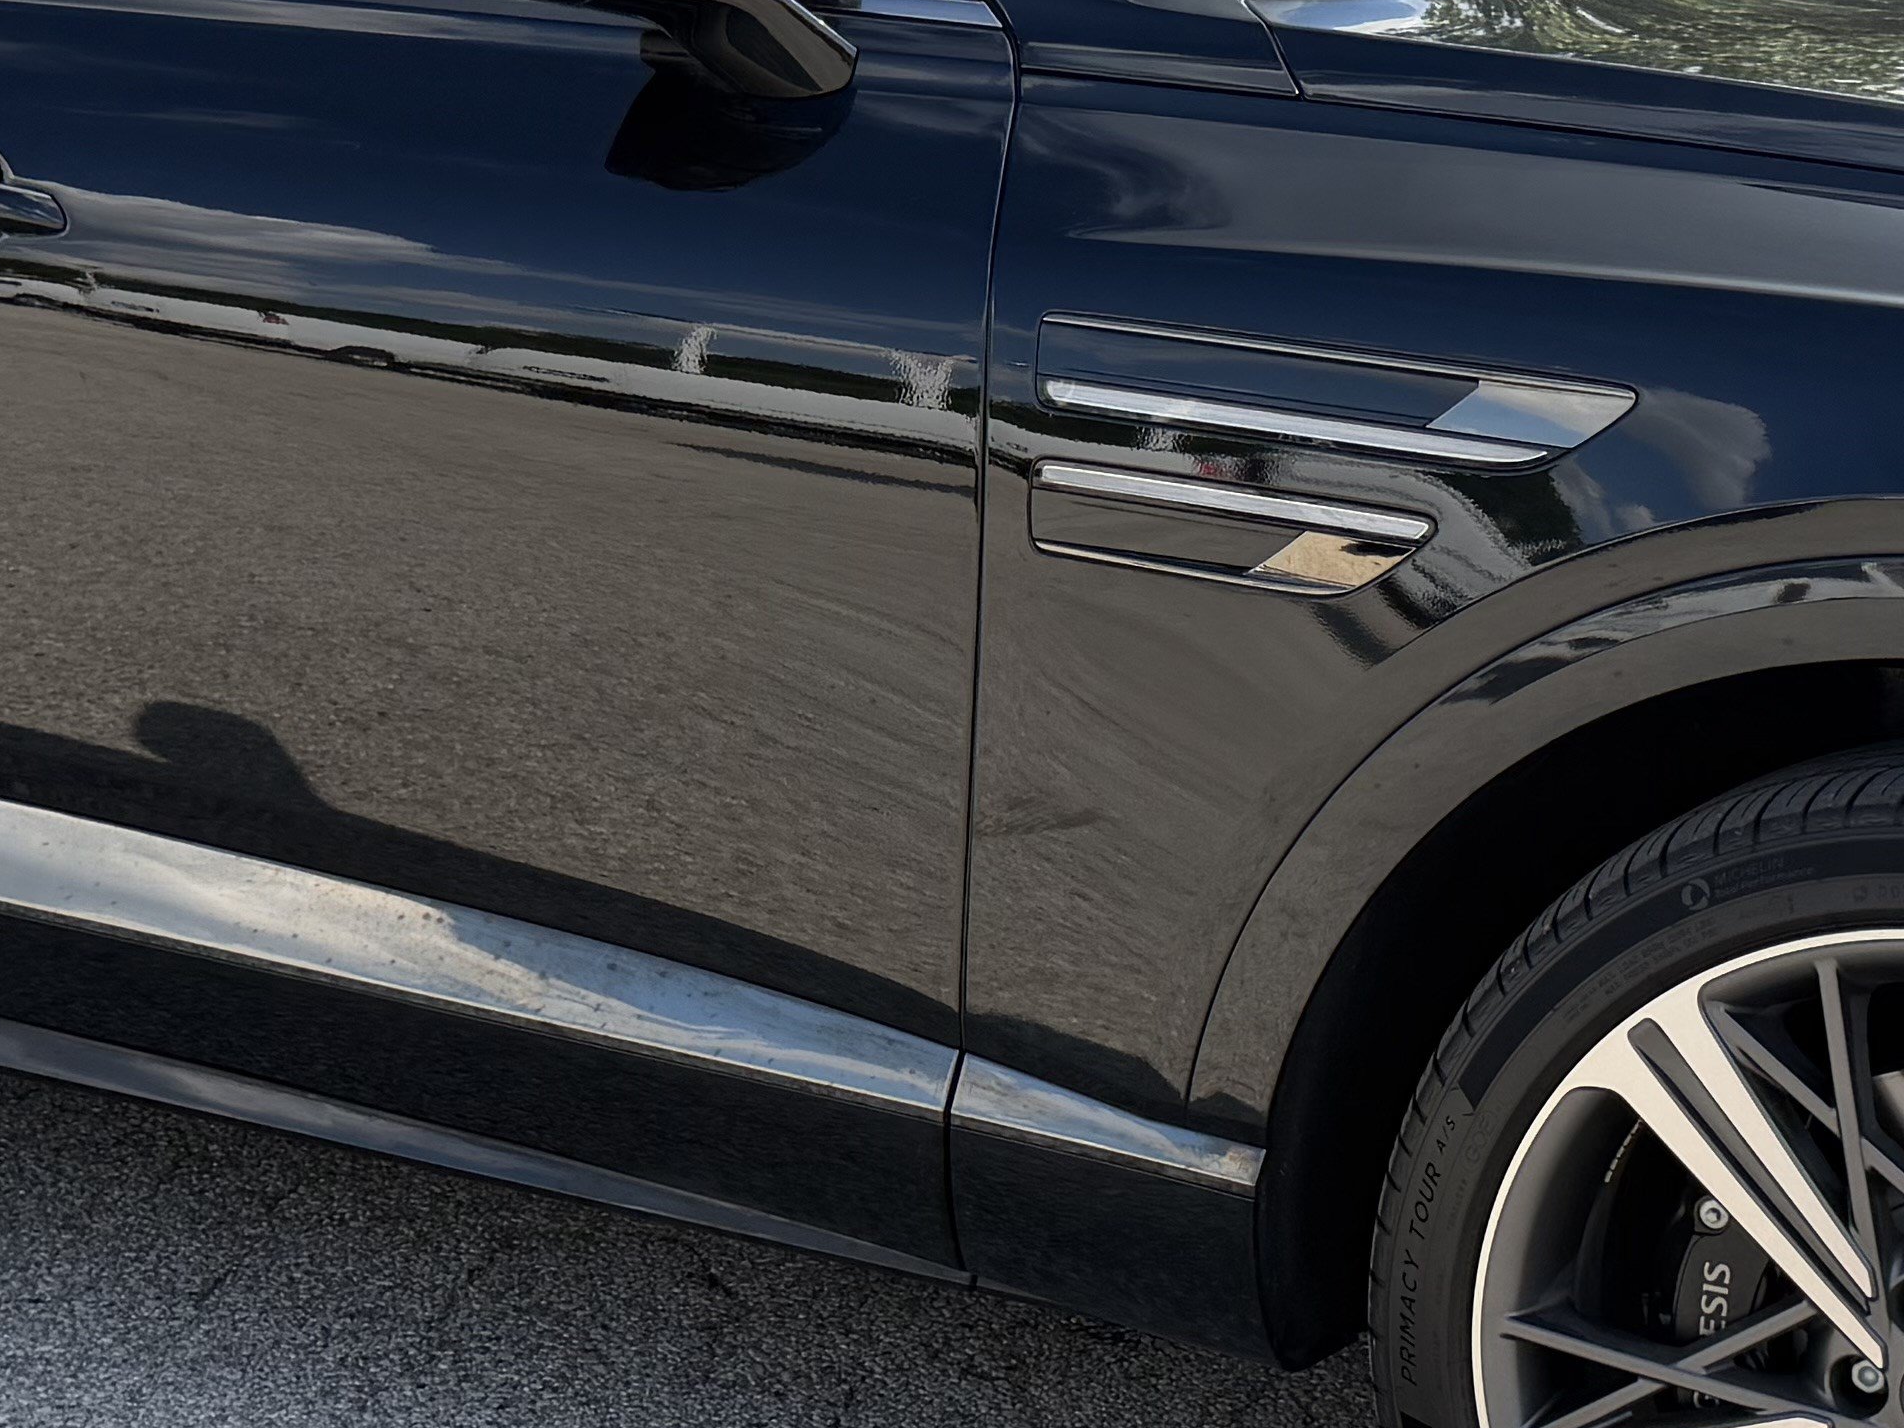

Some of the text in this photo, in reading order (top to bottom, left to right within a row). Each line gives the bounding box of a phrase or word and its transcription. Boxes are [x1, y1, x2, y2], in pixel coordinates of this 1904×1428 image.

[1436, 1114, 1457, 1157] A/S
[1408, 1162, 1442, 1239] TOUR
[1399, 1248, 1420, 1386] PRIMACY
